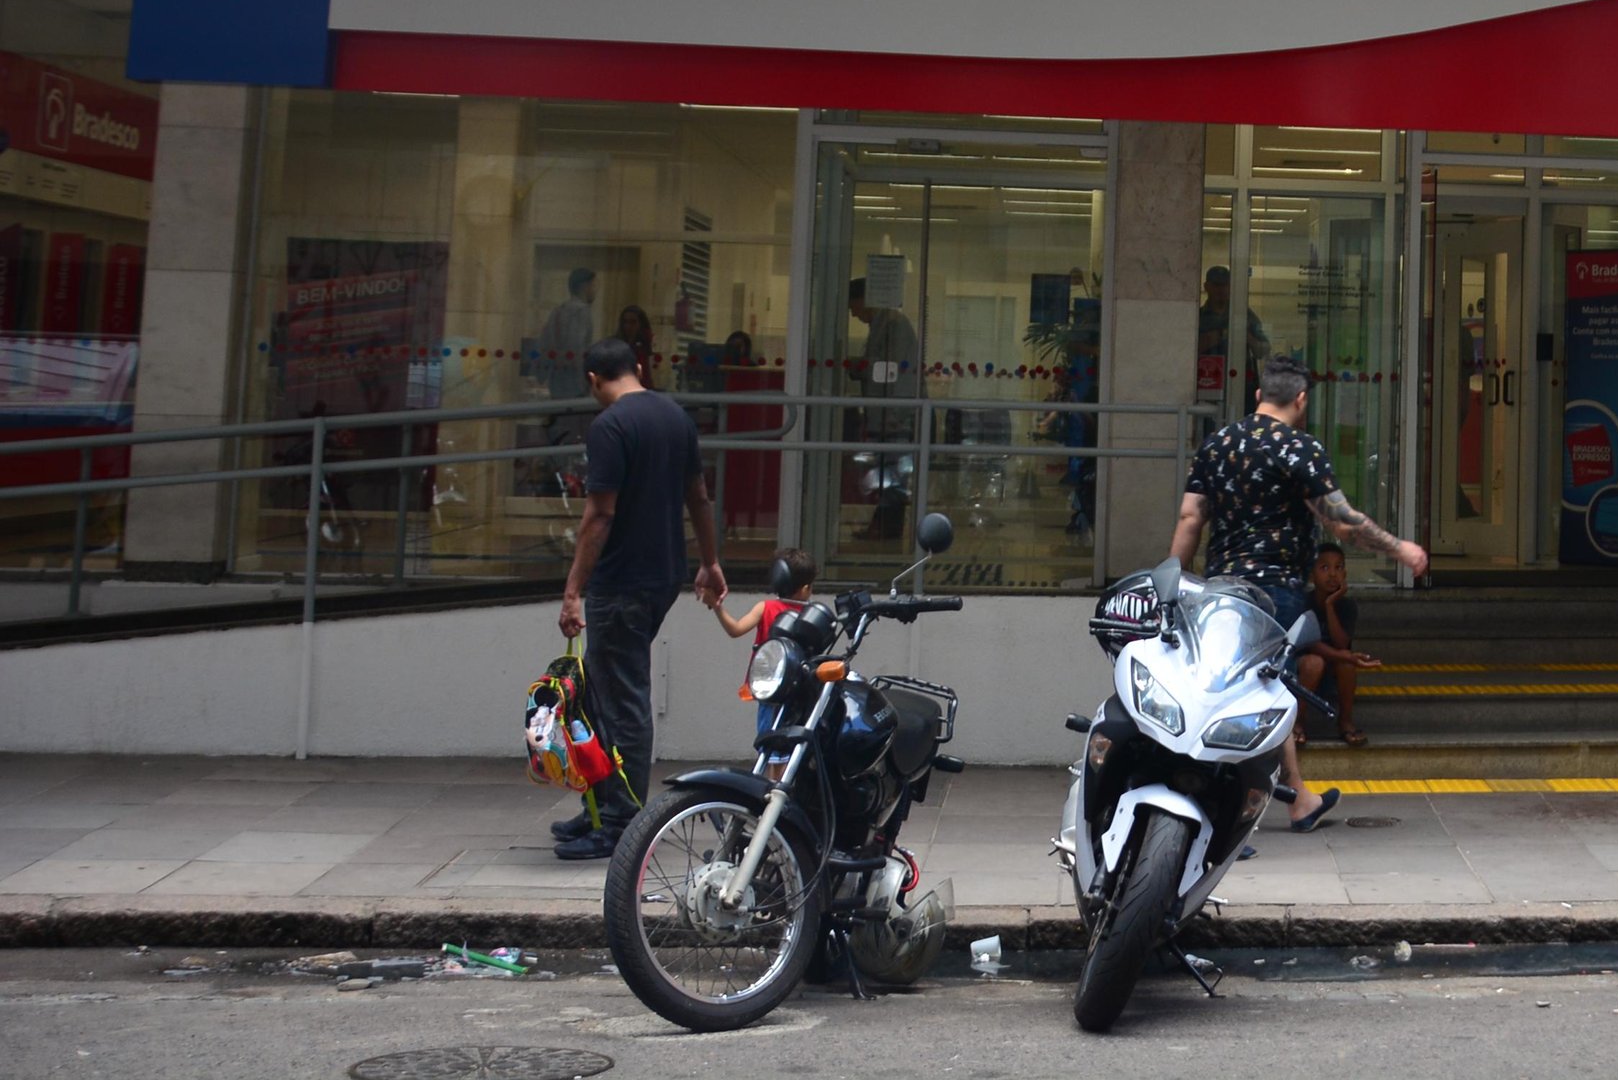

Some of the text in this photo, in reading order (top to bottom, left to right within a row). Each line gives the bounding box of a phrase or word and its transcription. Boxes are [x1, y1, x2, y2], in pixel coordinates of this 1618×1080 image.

[72, 102, 140, 151] Bradesco
[1581, 305, 1599, 314] Mais
[1588, 317, 1608, 326] pagar
